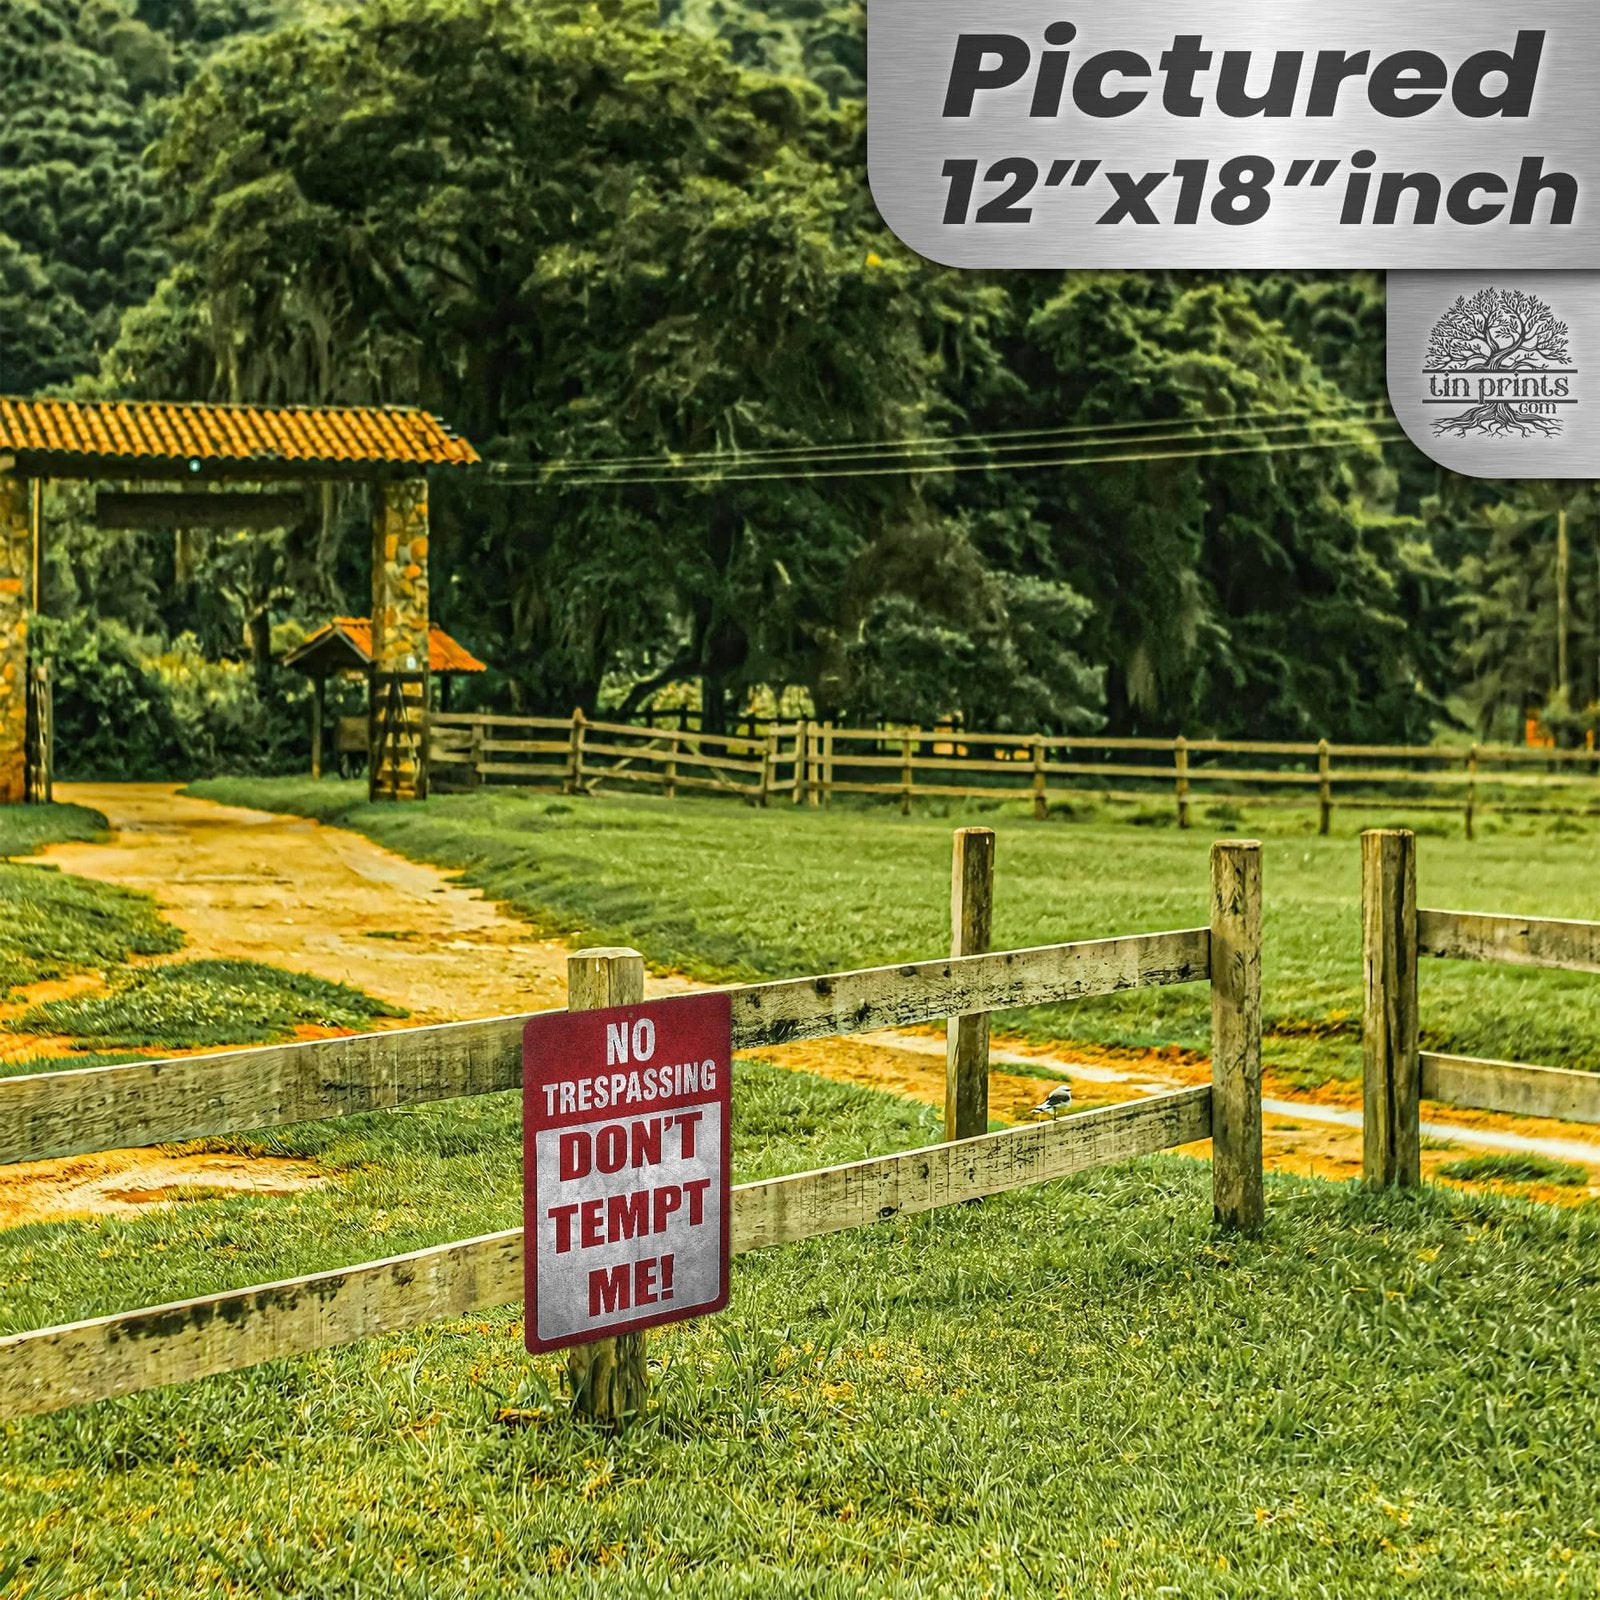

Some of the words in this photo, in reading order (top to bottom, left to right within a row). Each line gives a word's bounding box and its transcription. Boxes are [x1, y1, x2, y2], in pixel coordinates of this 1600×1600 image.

[606, 1018, 656, 1065] NO
[542, 1059, 716, 1116] TRESPASSING
[559, 1111, 702, 1181] DON'T
[547, 1178, 711, 1255] TEMPT
[588, 1254, 675, 1317] ME!
